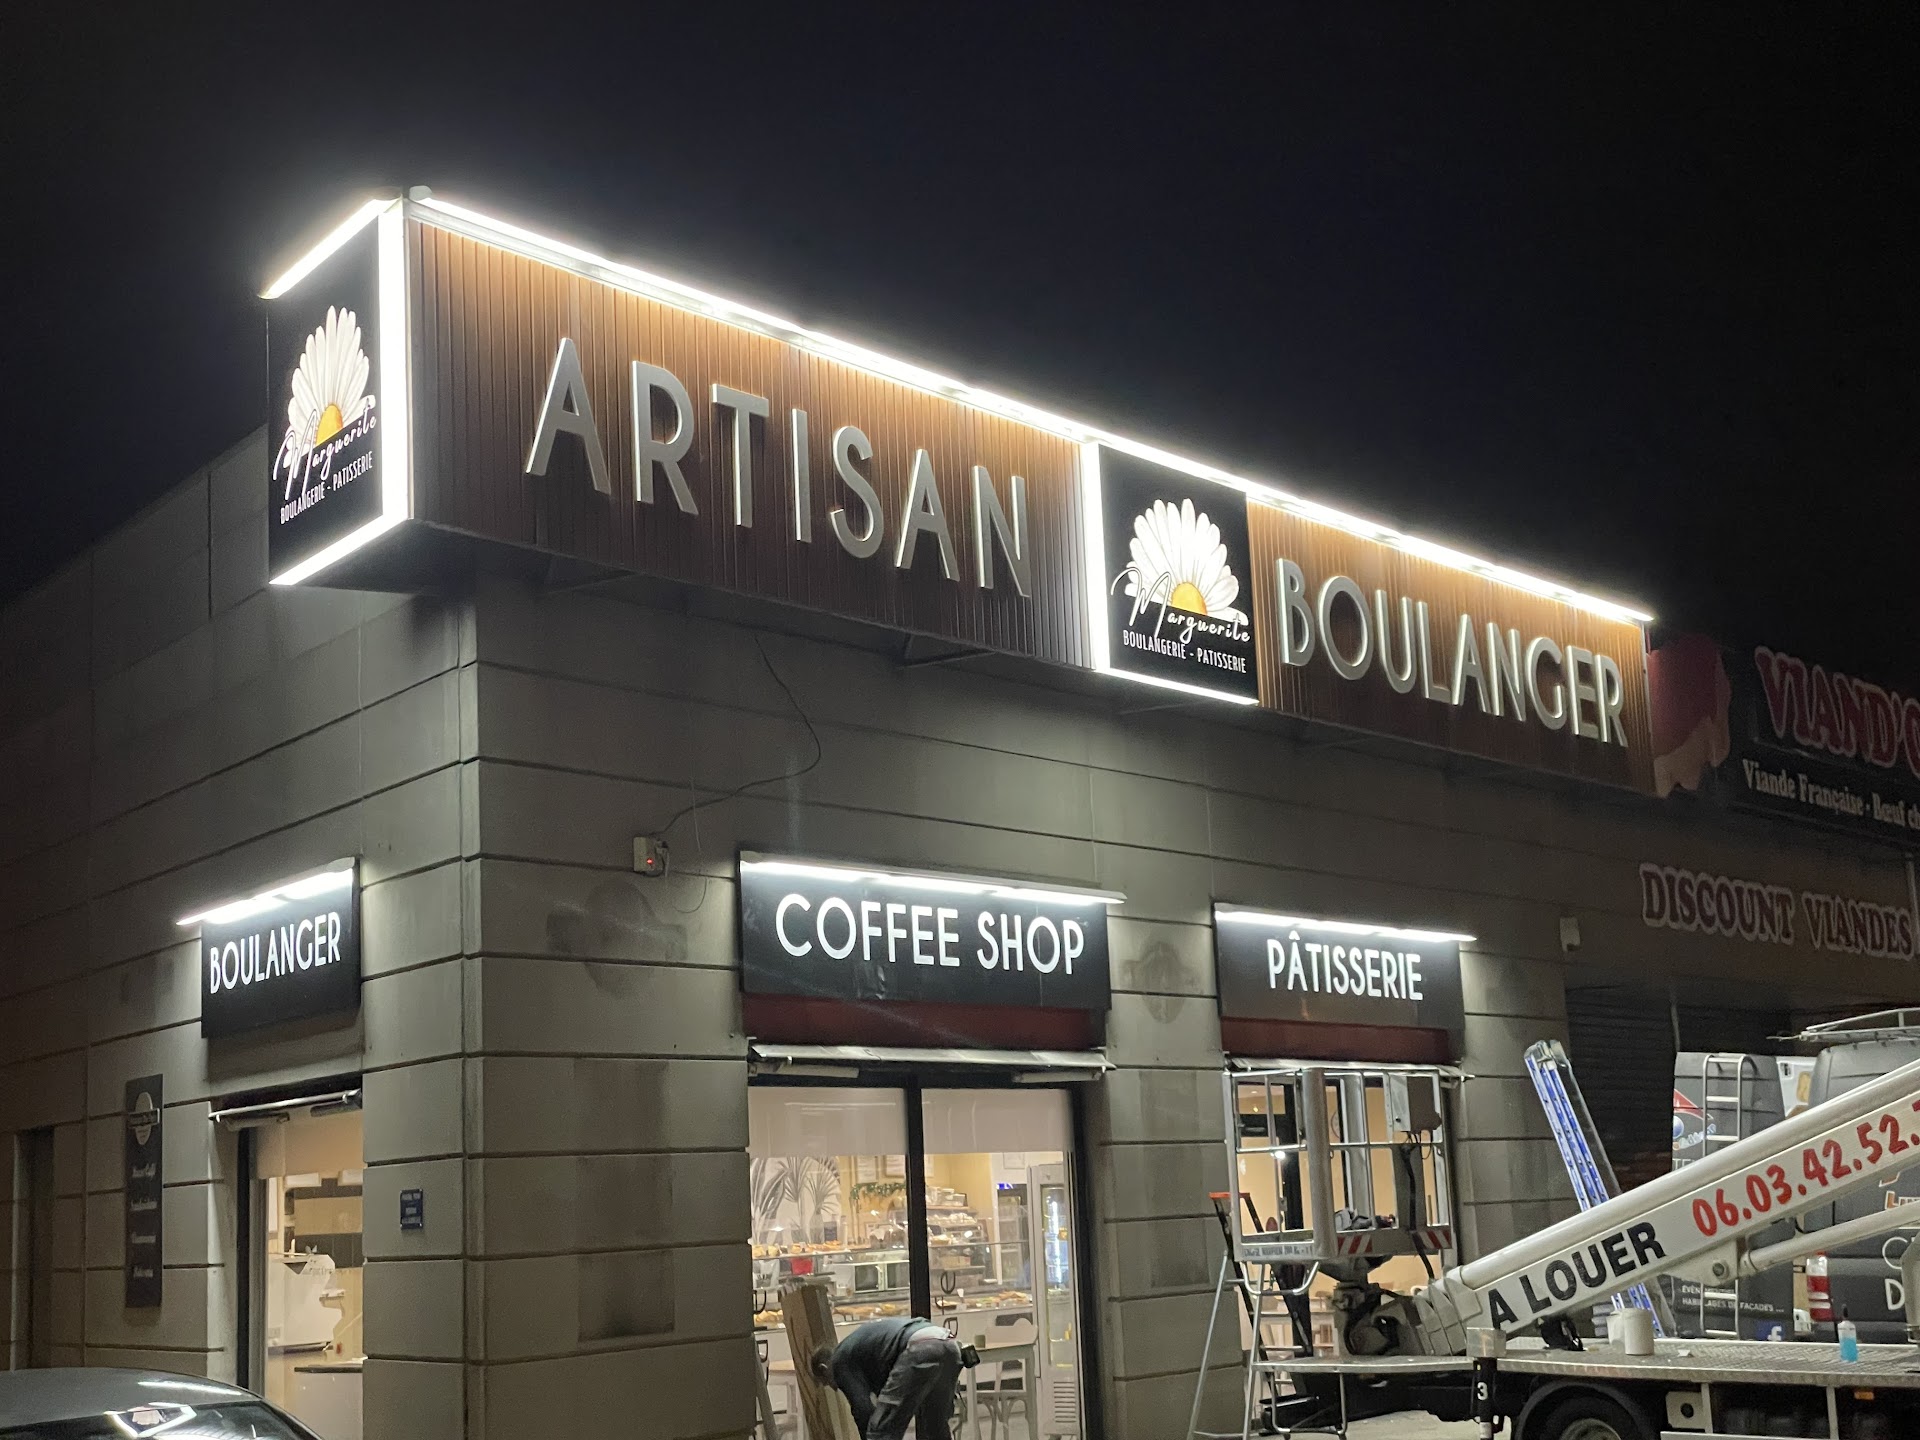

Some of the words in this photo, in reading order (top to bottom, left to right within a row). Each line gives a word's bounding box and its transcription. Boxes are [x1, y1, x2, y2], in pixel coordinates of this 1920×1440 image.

[272, 397, 377, 501] Marguerite
[280, 481, 326, 525] BOULANGERIE
[332, 450, 374, 491] PATISSERIE
[525, 337, 1032, 599] ARTISAN
[1110, 566, 1251, 645] Marguerite
[1123, 629, 1187, 660] BOULANGERIE
[1197, 647, 1247, 674] PATISSERIE
[1276, 557, 1629, 748] BOULANGER
[1742, 758, 1796, 799] Viande
[210, 911, 341, 994] BOULANGER
[775, 893, 961, 968] COFFEE
[976, 910, 1085, 975] SHOP
[1639, 862, 1796, 946] DISCOUNT
[1801, 891, 1915, 962] VIANDES
[1266, 930, 1424, 1001] PÂTISSERIE
[1692, 1100, 1920, 1237] 06.03.42.52.
[1488, 1288, 1519, 1331] A
[1519, 1222, 1667, 1314] LOUER
[1477, 1381, 1488, 1401] 3
